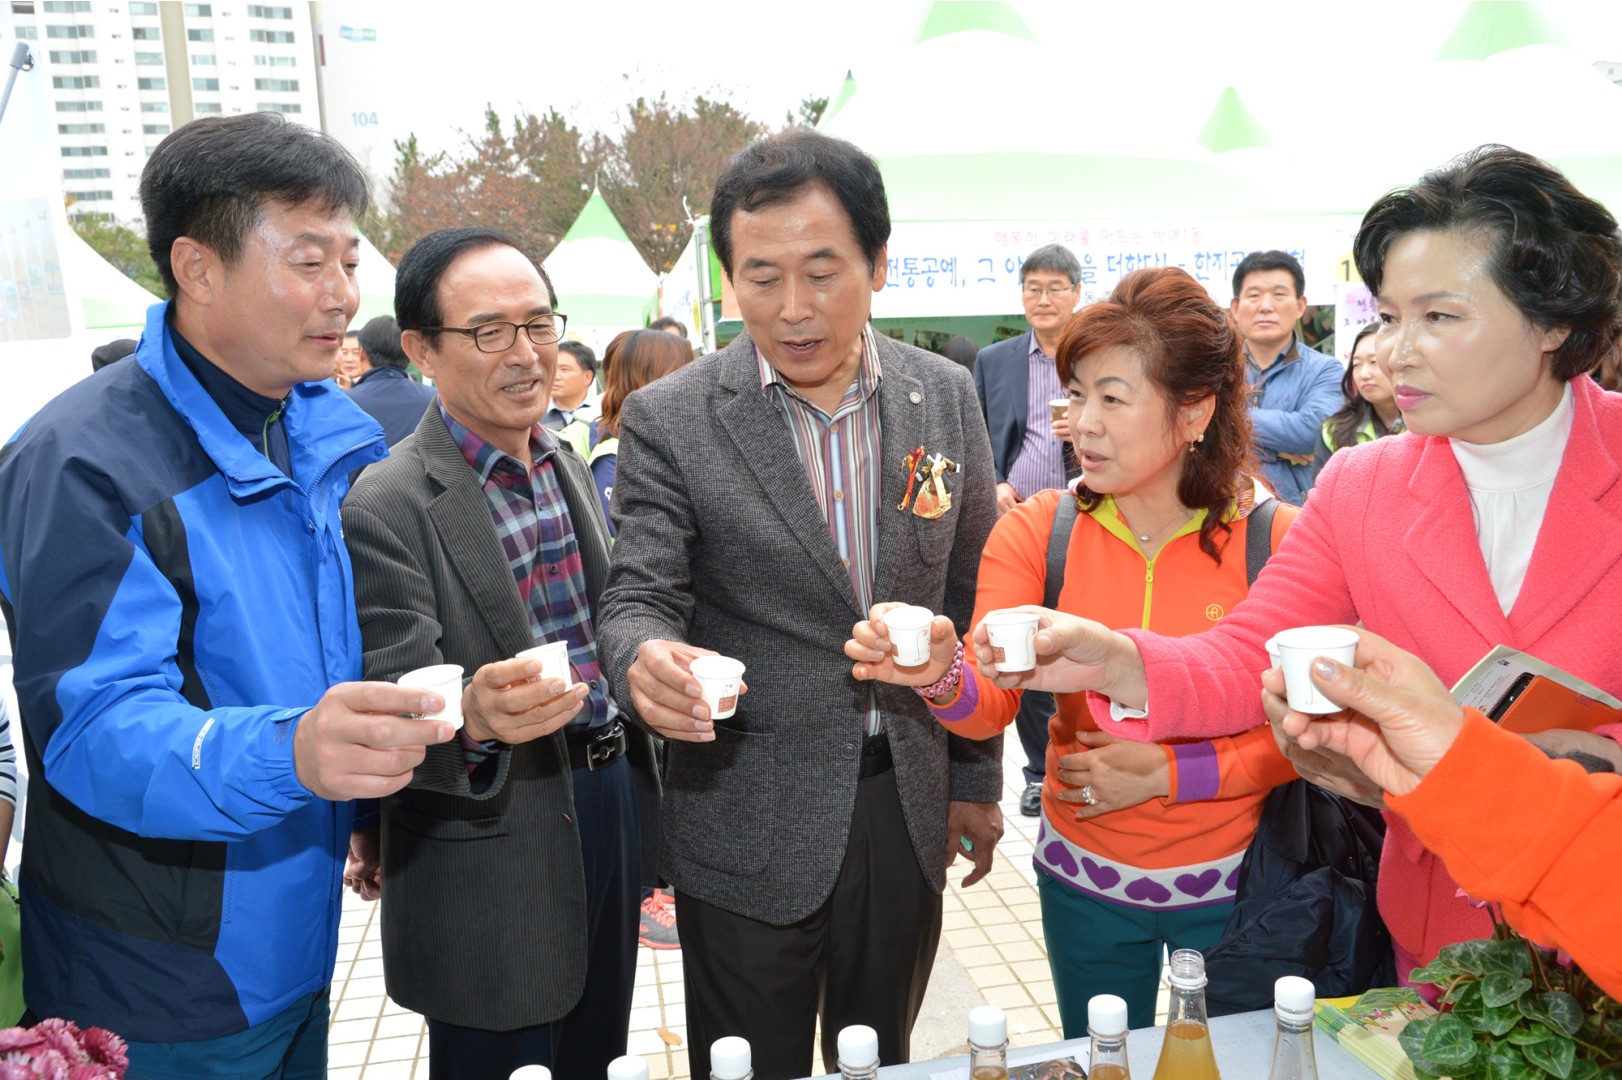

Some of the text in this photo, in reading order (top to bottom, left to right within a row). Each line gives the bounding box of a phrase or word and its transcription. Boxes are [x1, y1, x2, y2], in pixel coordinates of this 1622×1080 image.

[351, 111, 379, 127] 104
[993, 230, 1039, 248] 행복한
[1100, 228, 1144, 245] 만드는
[977, 257, 997, 284] 그
